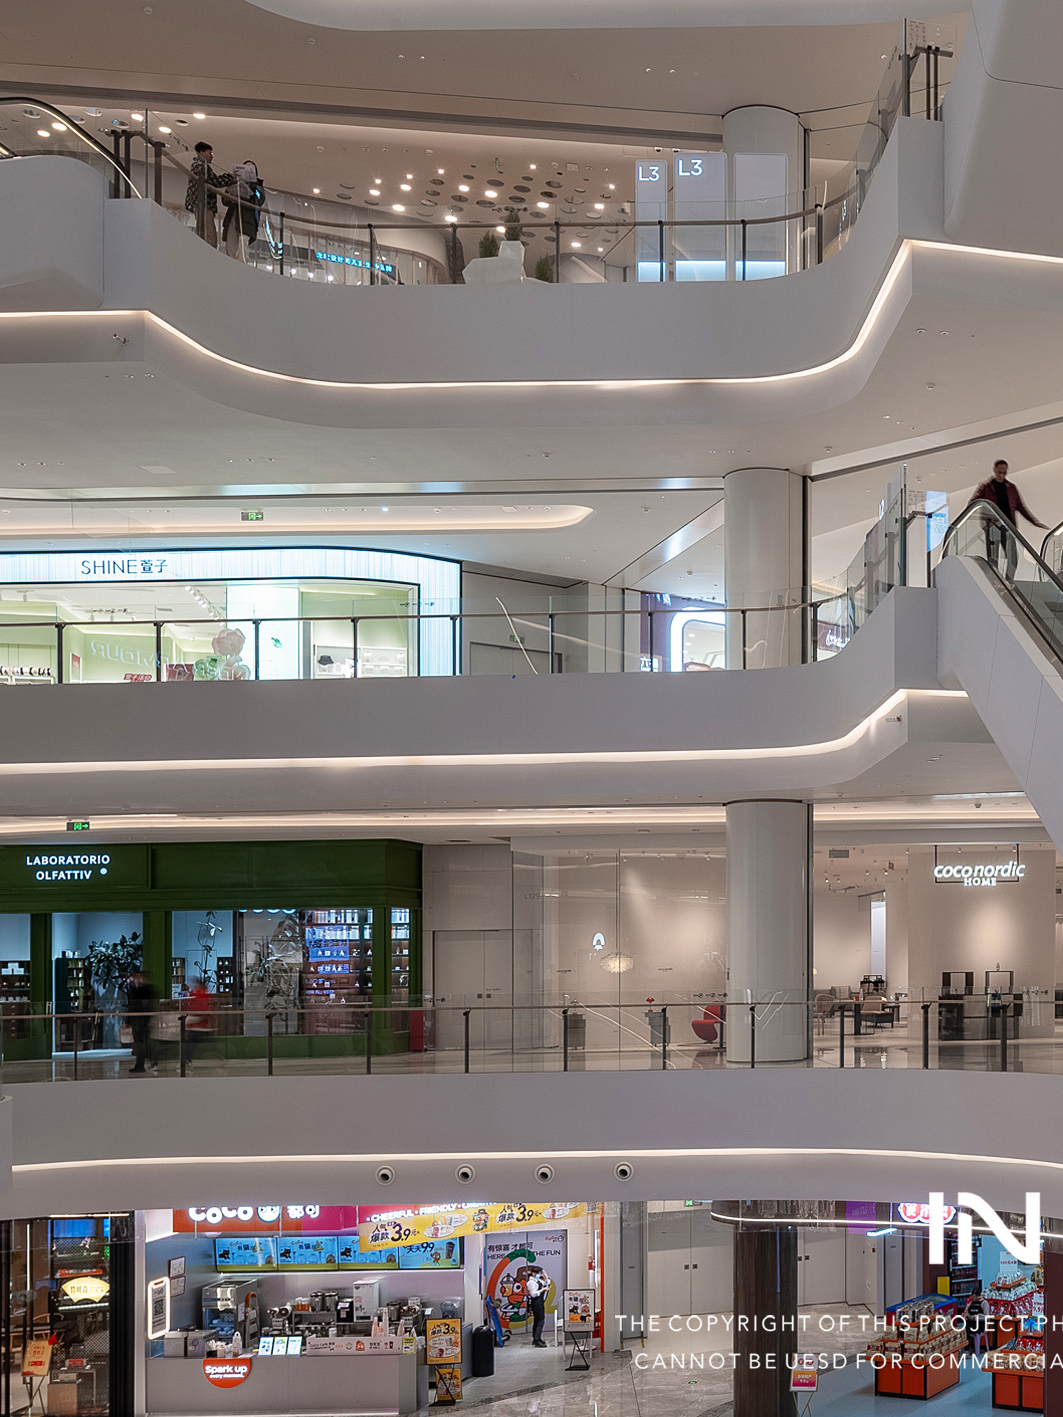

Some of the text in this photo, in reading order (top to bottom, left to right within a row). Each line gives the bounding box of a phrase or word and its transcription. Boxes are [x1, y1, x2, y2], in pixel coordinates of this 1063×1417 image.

[638, 166, 660, 182] L3
[678, 159, 704, 177] L3
[26, 854, 111, 866] LABORATORIO
[963, 877, 997, 887] HOME
[371, 1209, 414, 1222] CHEERFUL
[419, 1203, 458, 1216] FRIENDLY
[204, 1365, 248, 1374] Spark up
